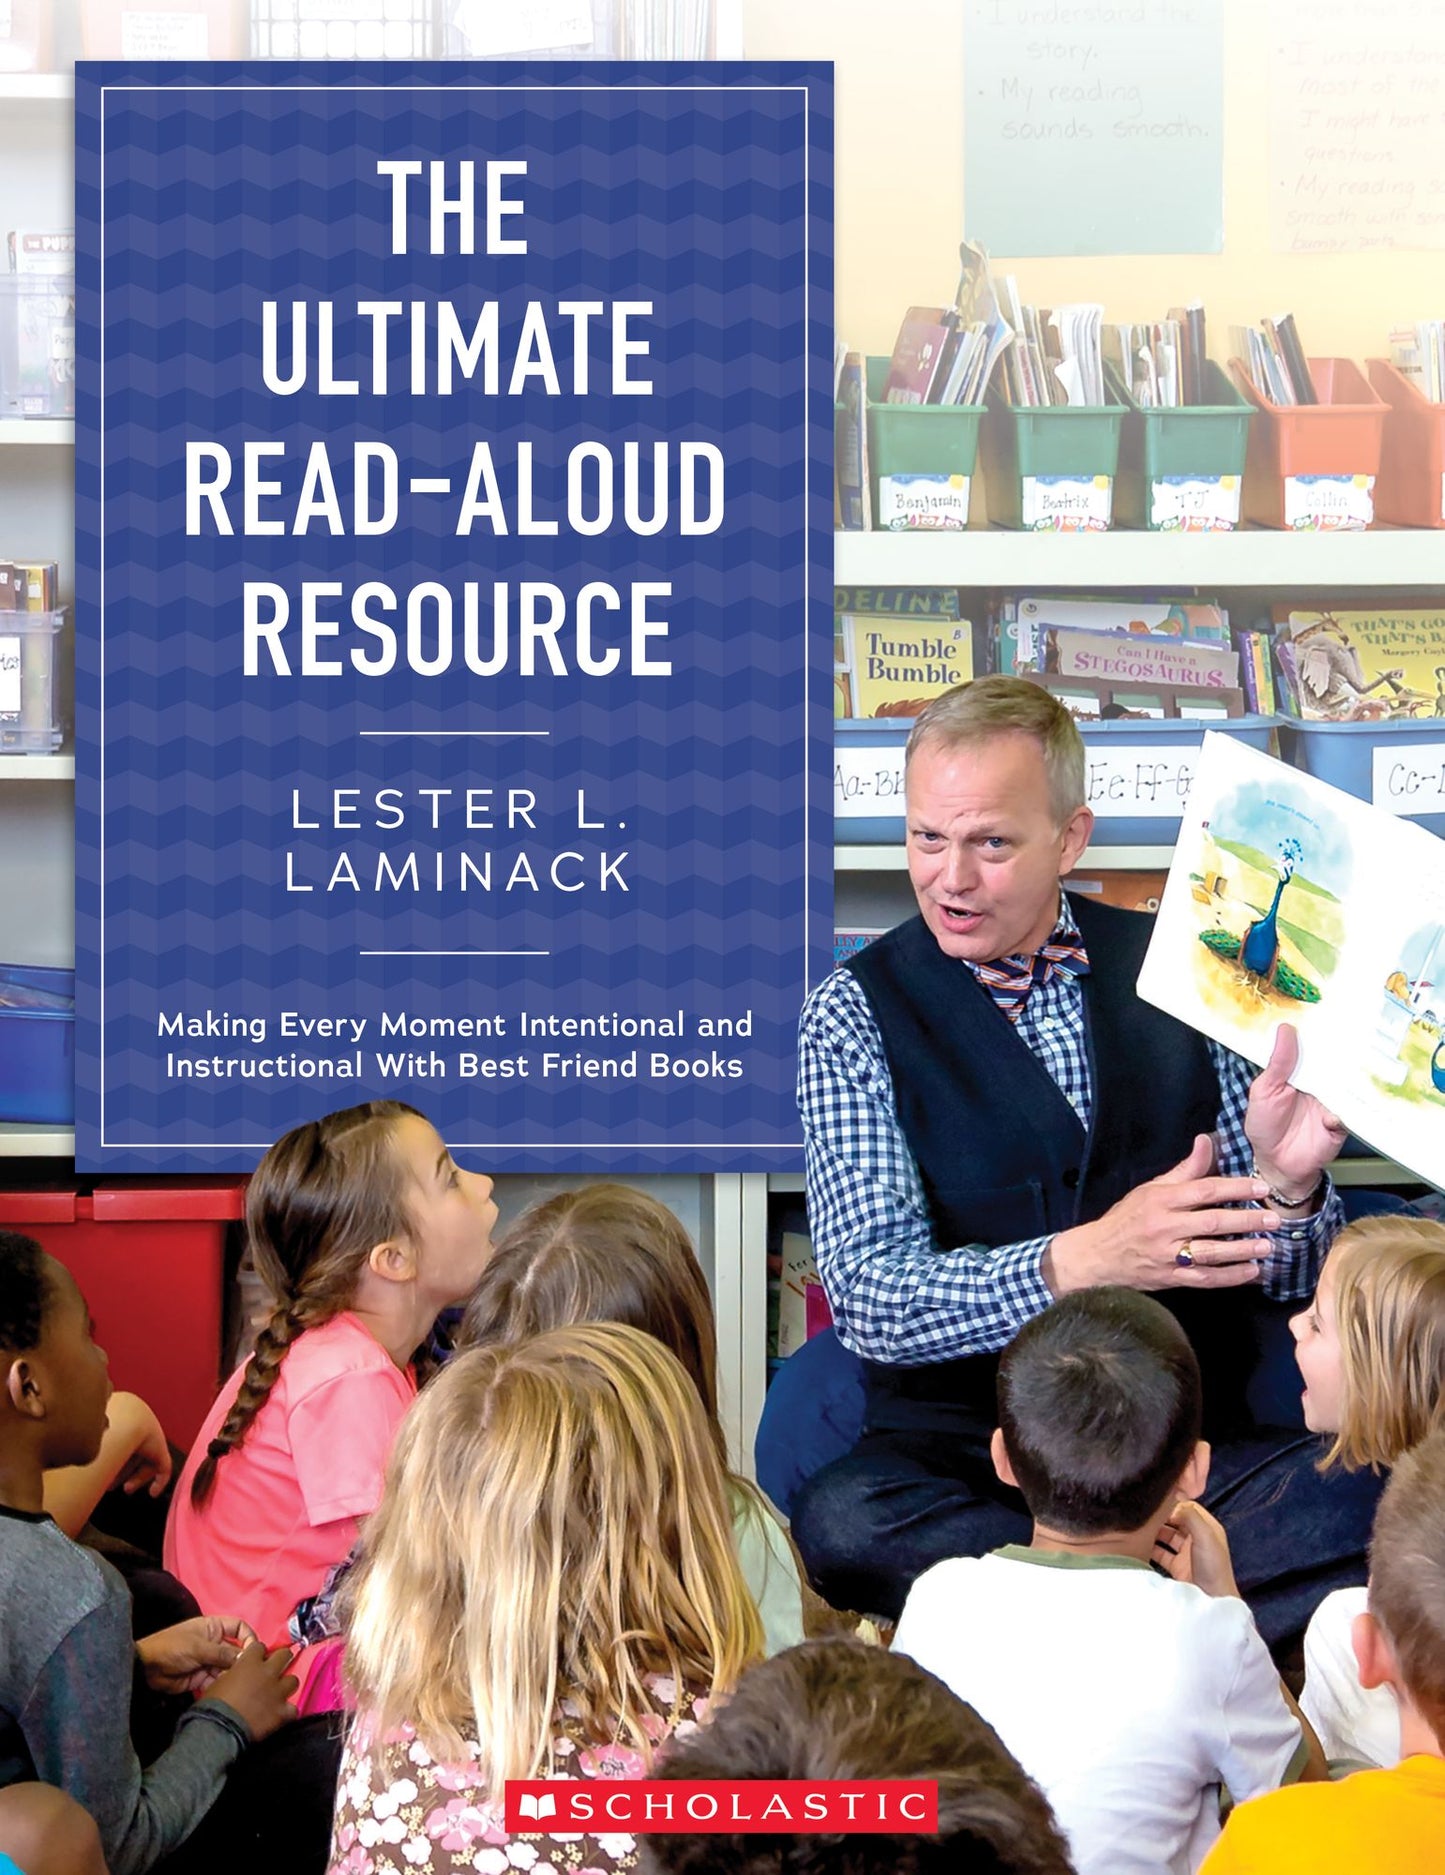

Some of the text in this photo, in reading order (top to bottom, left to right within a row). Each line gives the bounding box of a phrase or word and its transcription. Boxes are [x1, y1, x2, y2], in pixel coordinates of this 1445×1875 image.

[1017, 1, 1145, 25] understand
[1155, 2, 1198, 24] the
[1026, 38, 1099, 71] story.
[1001, 77, 1144, 119] My reading
[1001, 113, 1209, 140] sounds smooth.
[1295, 173, 1328, 201] My
[1338, 177, 1415, 209] reading
[1285, 206, 1358, 226] smooth
[1365, 206, 1407, 224] with
[896, 494, 961, 512] Benjamin
[866, 632, 957, 659] Tumble
[1430, 632, 1445, 645] B
[1117, 645, 1143, 658] Can
[1153, 650, 1186, 664] Have
[866, 657, 961, 685] Bumble
